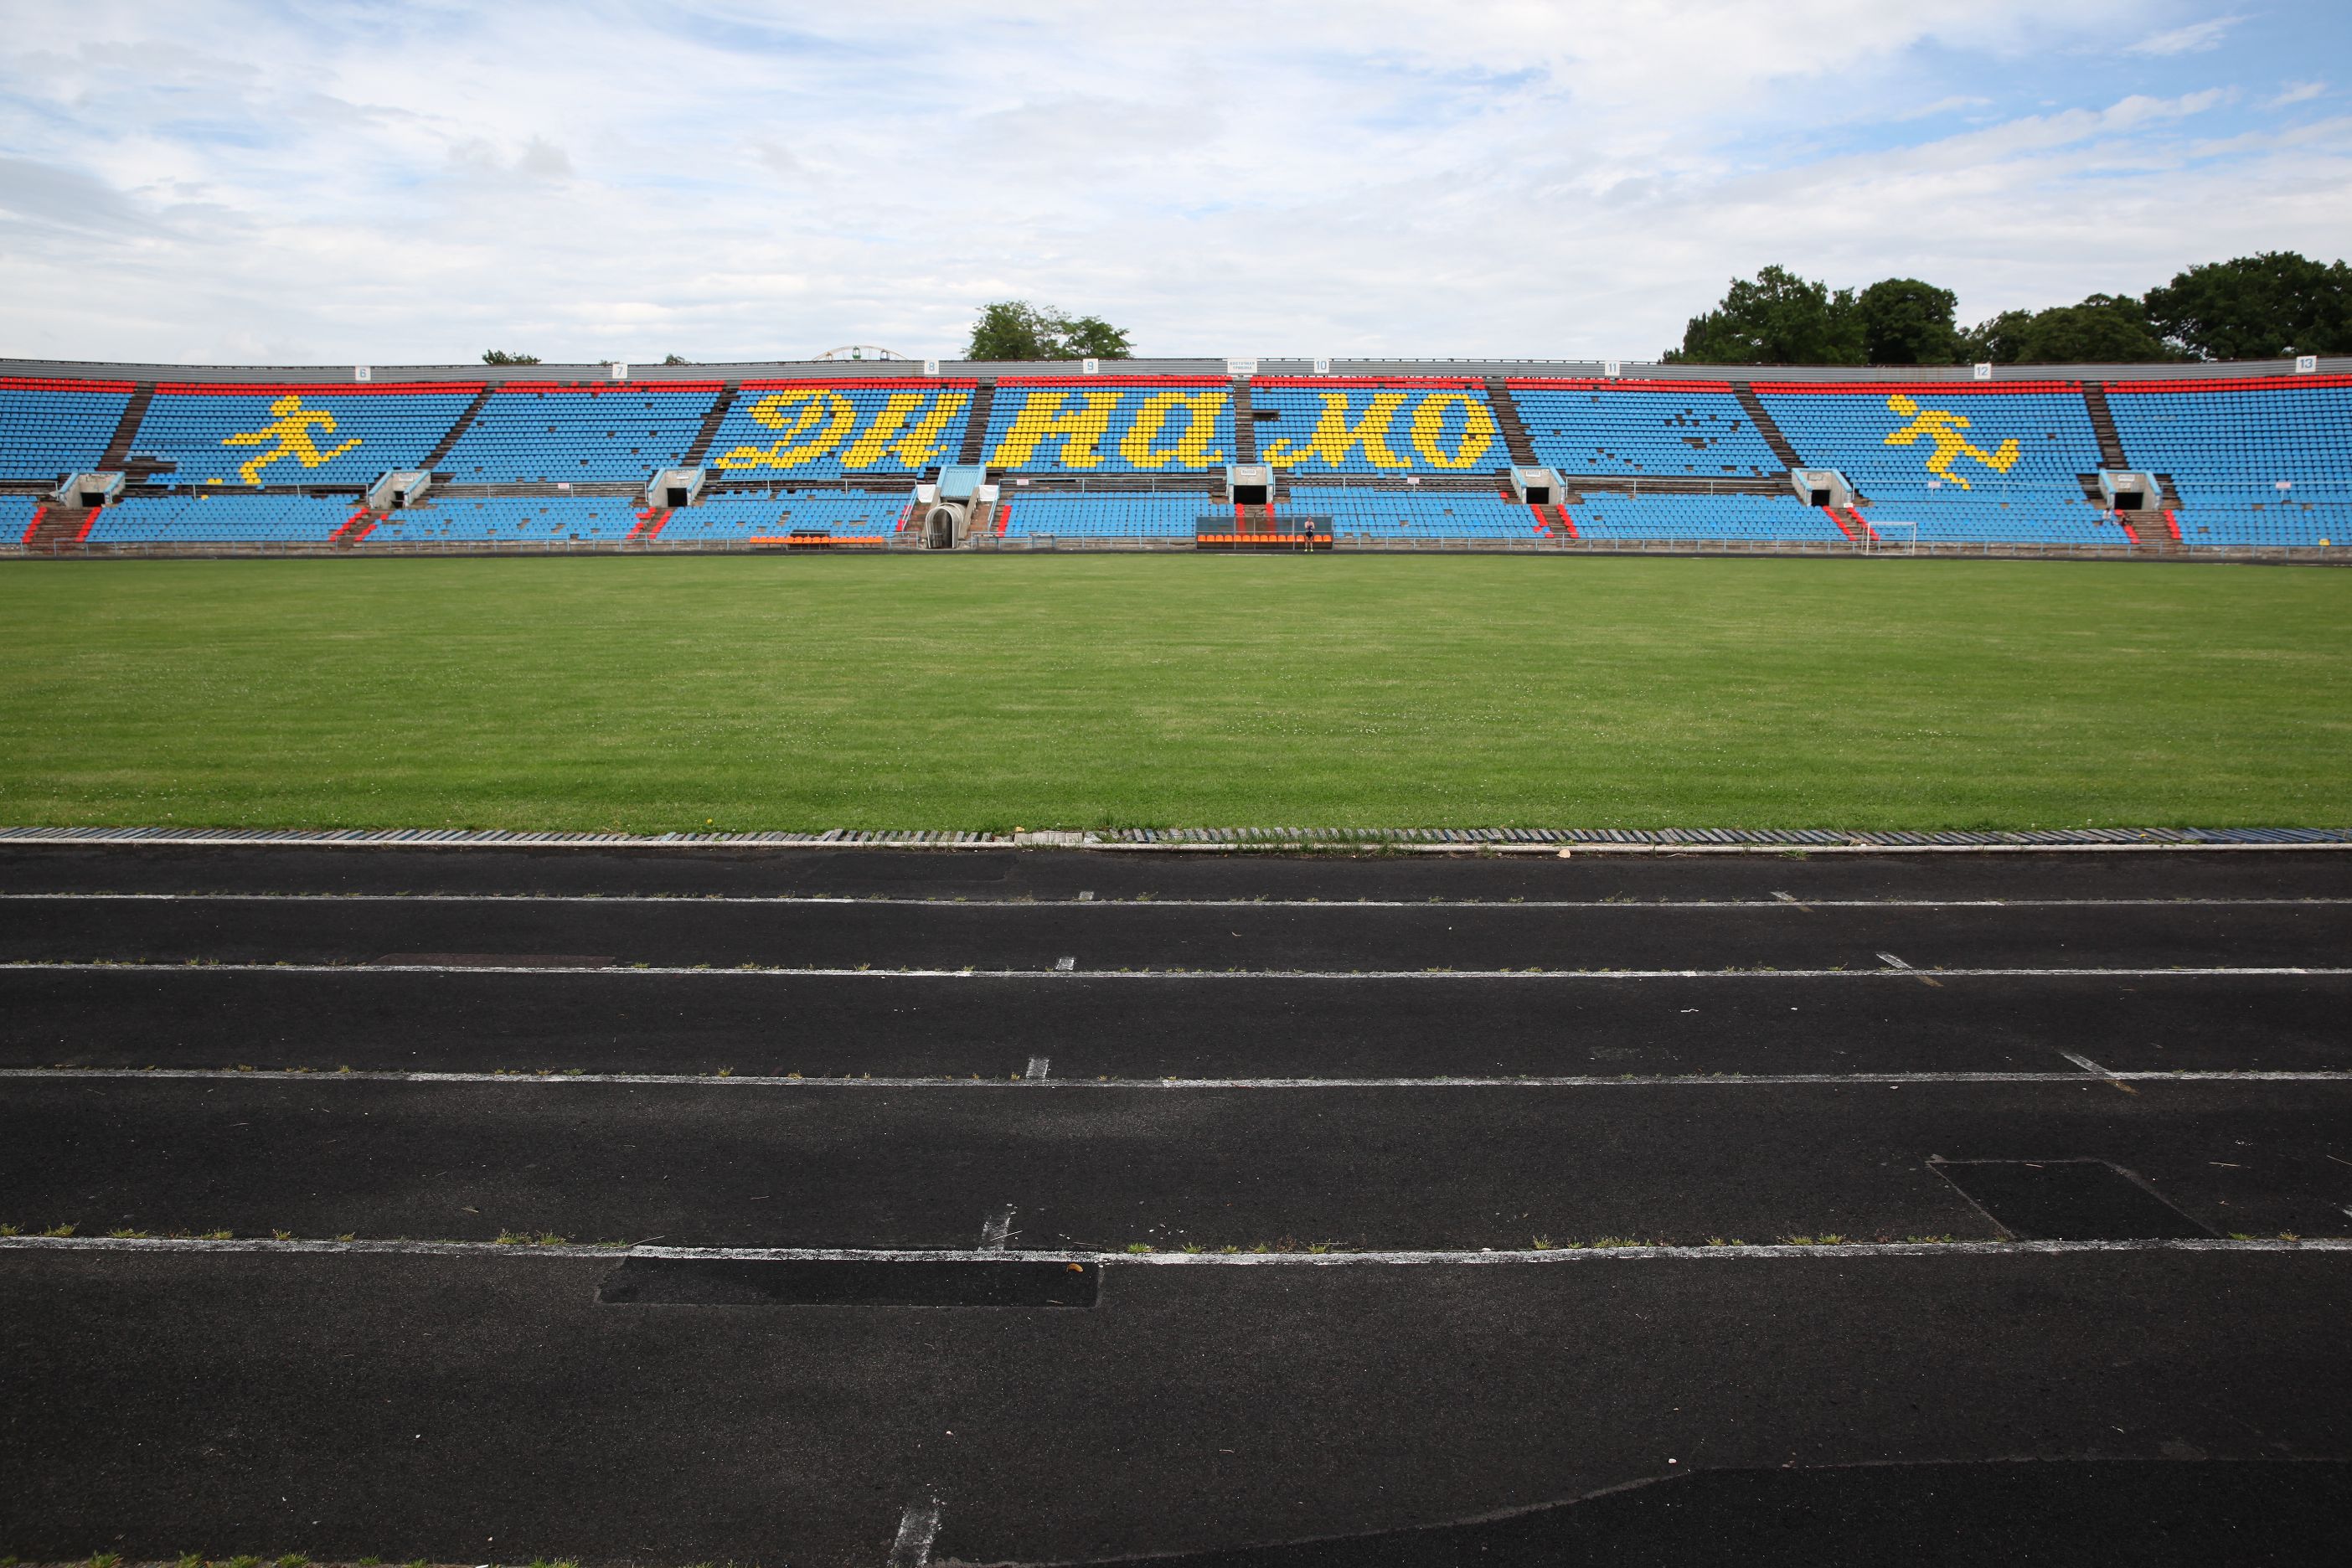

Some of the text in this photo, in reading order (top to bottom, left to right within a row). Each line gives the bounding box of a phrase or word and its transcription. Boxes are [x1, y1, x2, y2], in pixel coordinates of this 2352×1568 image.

[929, 362, 936, 371] 8
[1087, 361, 1094, 371] 9
[1316, 360, 1327, 370] 10
[1608, 363, 1617, 373] 11
[2300, 358, 2313, 369] 13
[359, 369, 367, 378] 6
[616, 367, 624, 376] 7
[1977, 366, 1988, 376] 12
